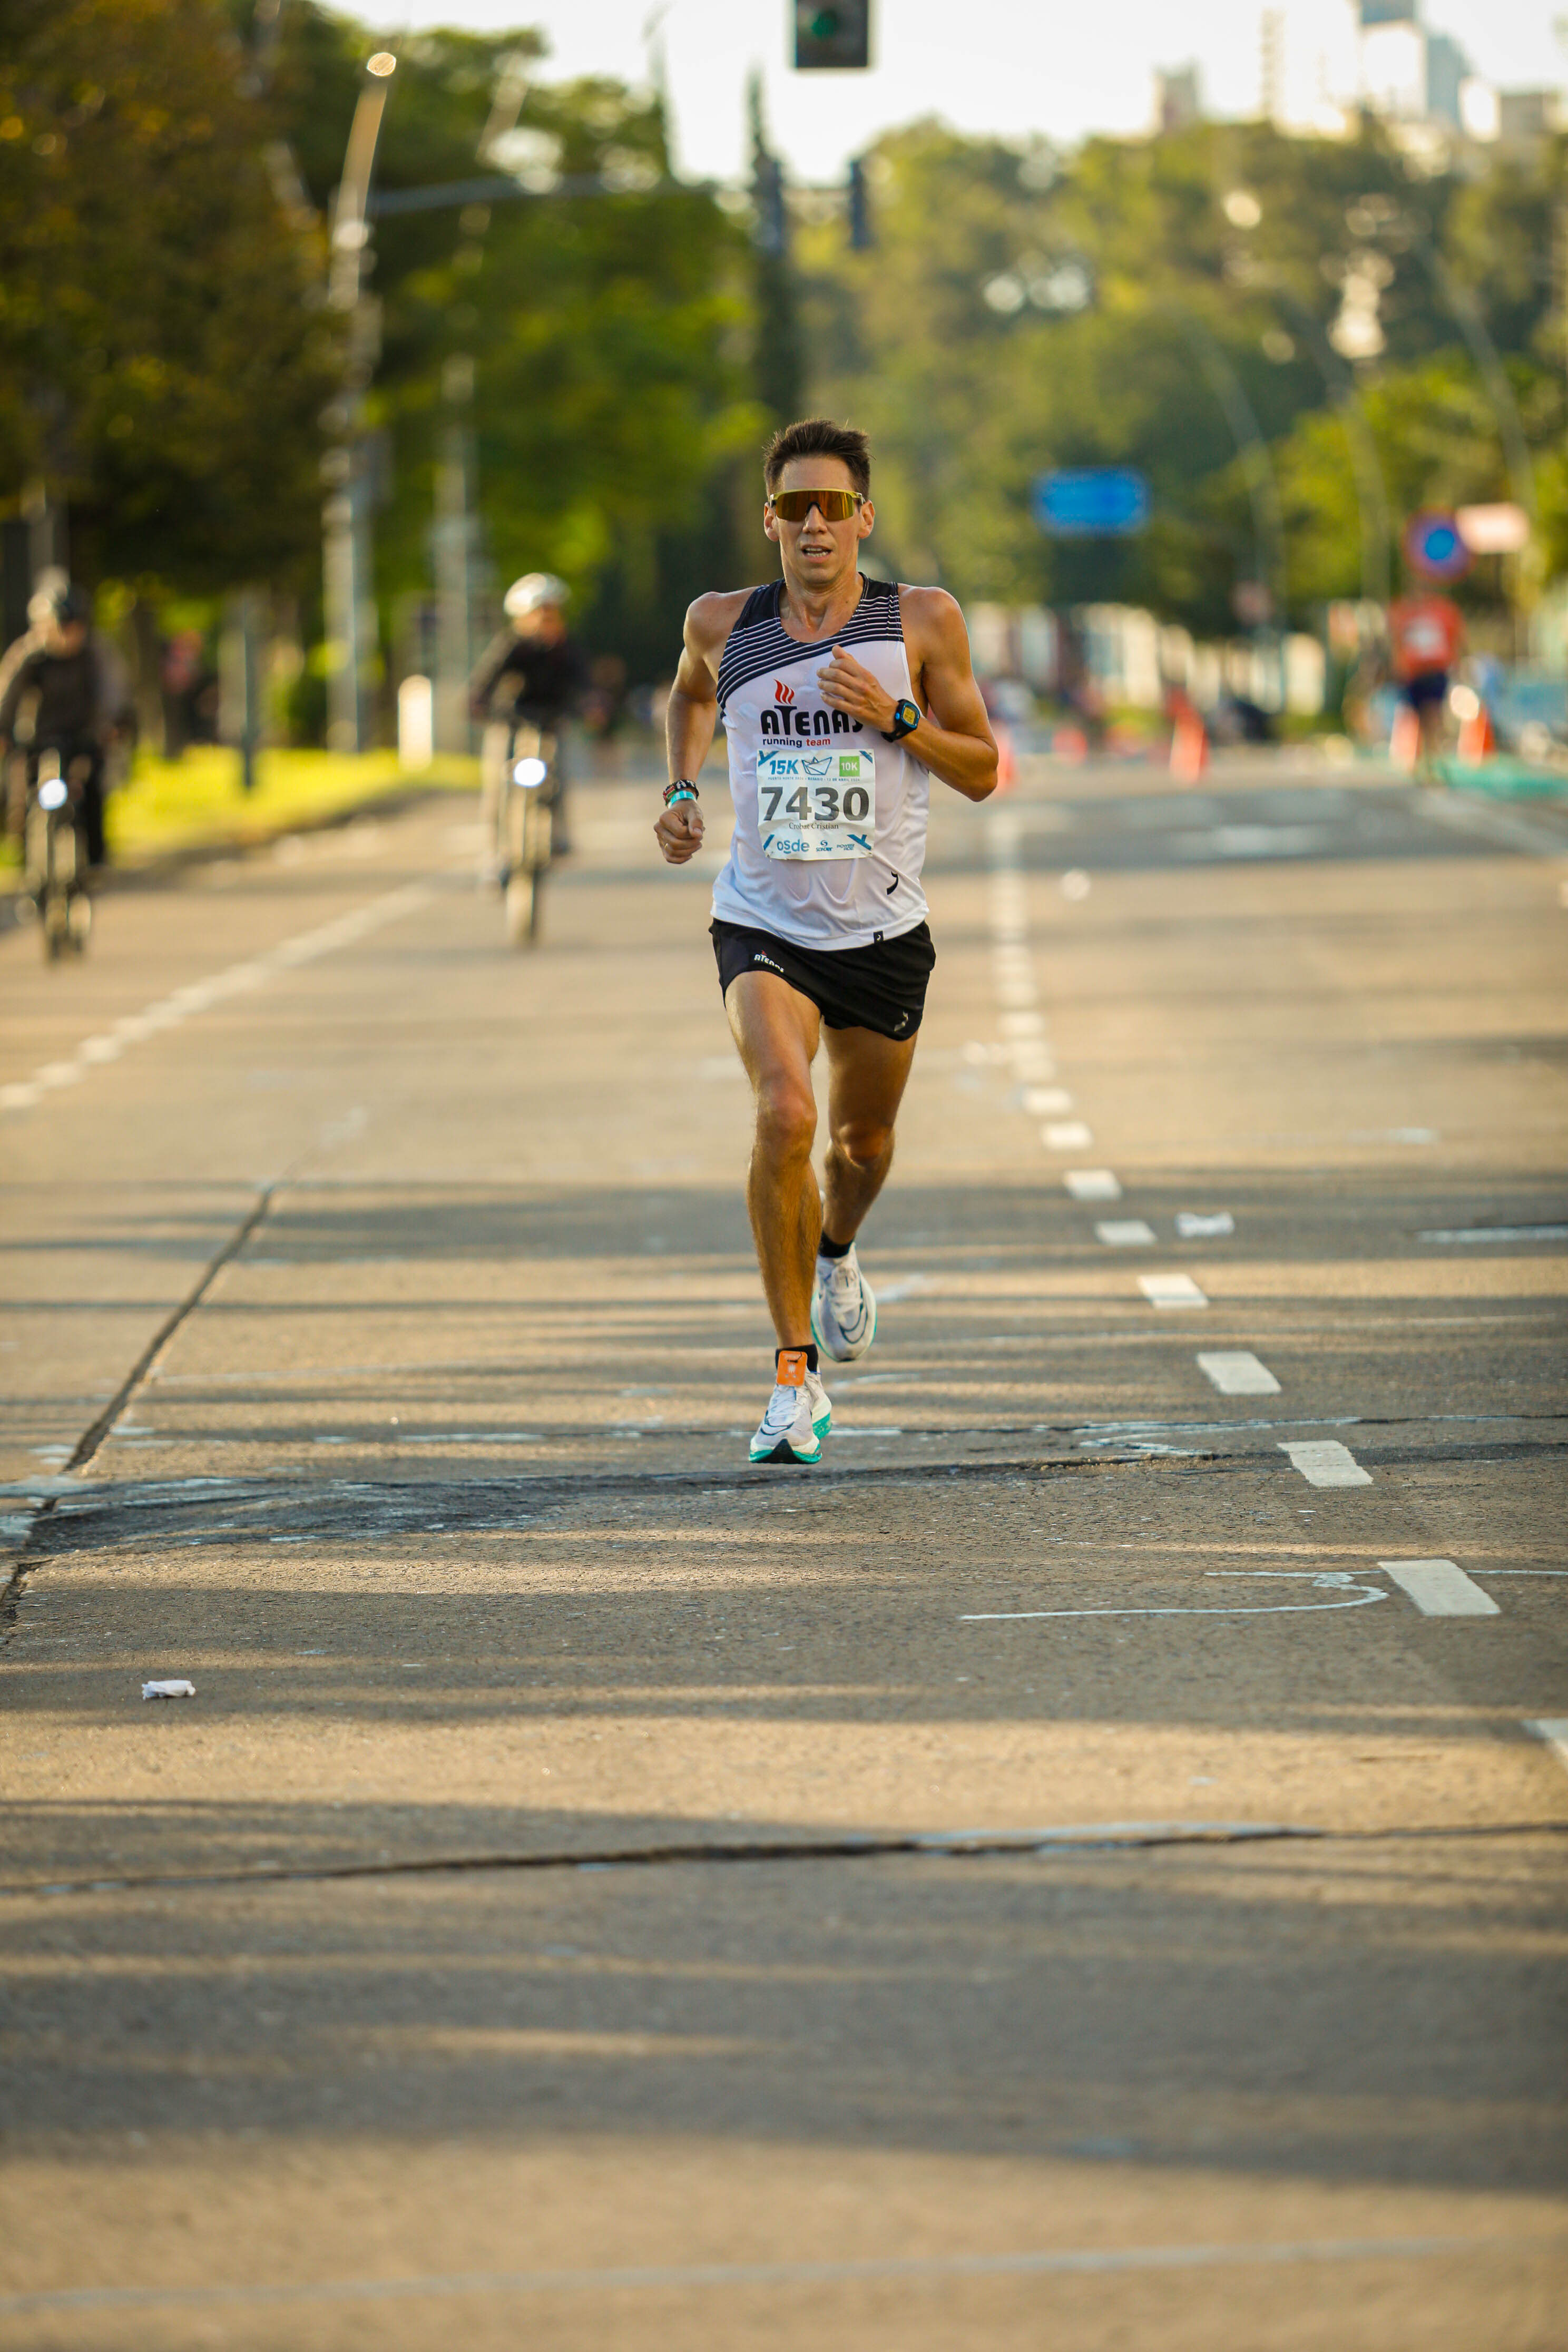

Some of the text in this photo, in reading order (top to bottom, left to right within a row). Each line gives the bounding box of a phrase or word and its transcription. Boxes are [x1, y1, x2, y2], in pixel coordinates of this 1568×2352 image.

[763, 738, 802, 748] running
[770, 759, 798, 775] 15K
[841, 762, 857, 771] 10K
[761, 787, 869, 821] 7430
[777, 839, 809, 852] osde
